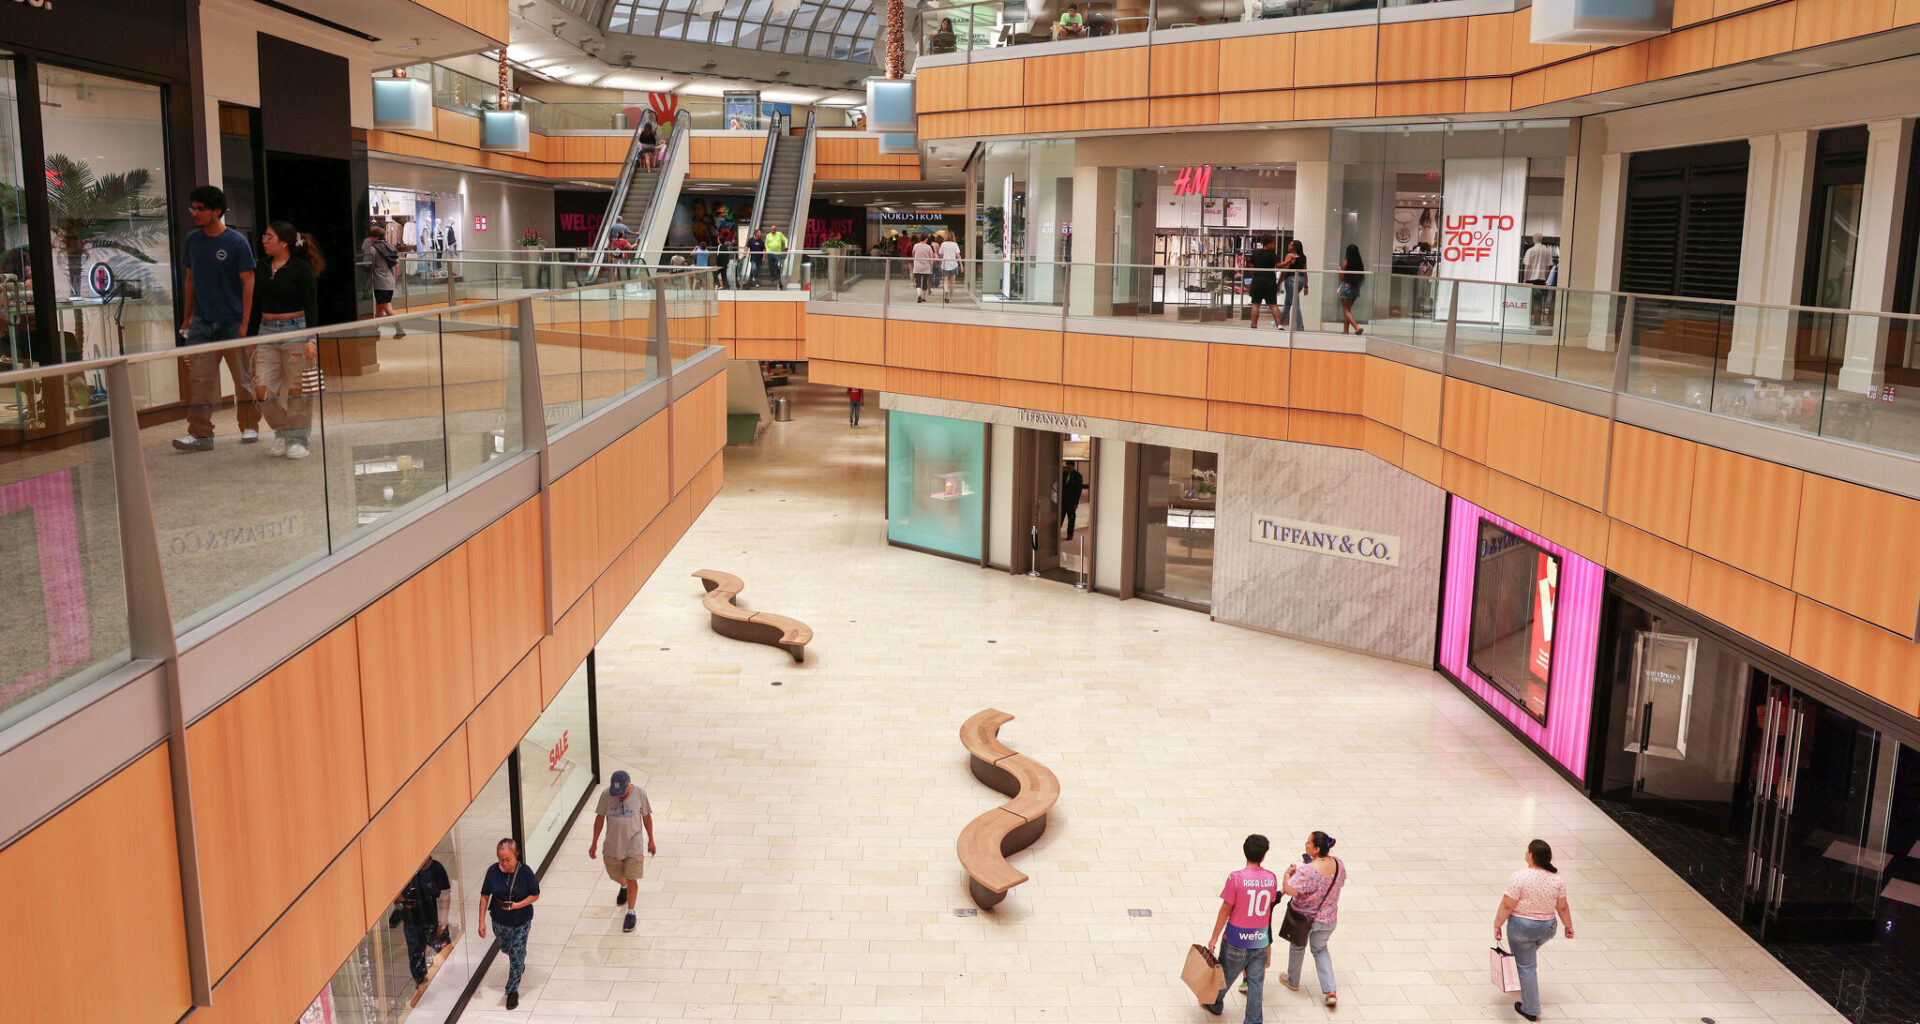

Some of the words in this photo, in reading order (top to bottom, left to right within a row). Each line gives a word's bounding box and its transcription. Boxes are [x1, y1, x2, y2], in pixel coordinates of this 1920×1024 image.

[1173, 166, 1212, 196] H&M
[881, 212, 942, 220] NORDSTROM
[1446, 214, 1478, 230] UP
[1482, 215, 1514, 231] TO
[806, 218, 827, 233] FLIX
[1445, 231, 1494, 247] 70%
[1443, 246, 1491, 262] OFF
[1502, 301, 1528, 310] SALE
[1018, 409, 1059, 426] TIFFANY
[1059, 416, 1067, 427] &
[1258, 519, 1339, 551] TIFFANY
[1339, 535, 1355, 554] &
[549, 729, 569, 771] SALE
[1243, 879, 1260, 888] RAFA
[1247, 889, 1271, 917] 10
